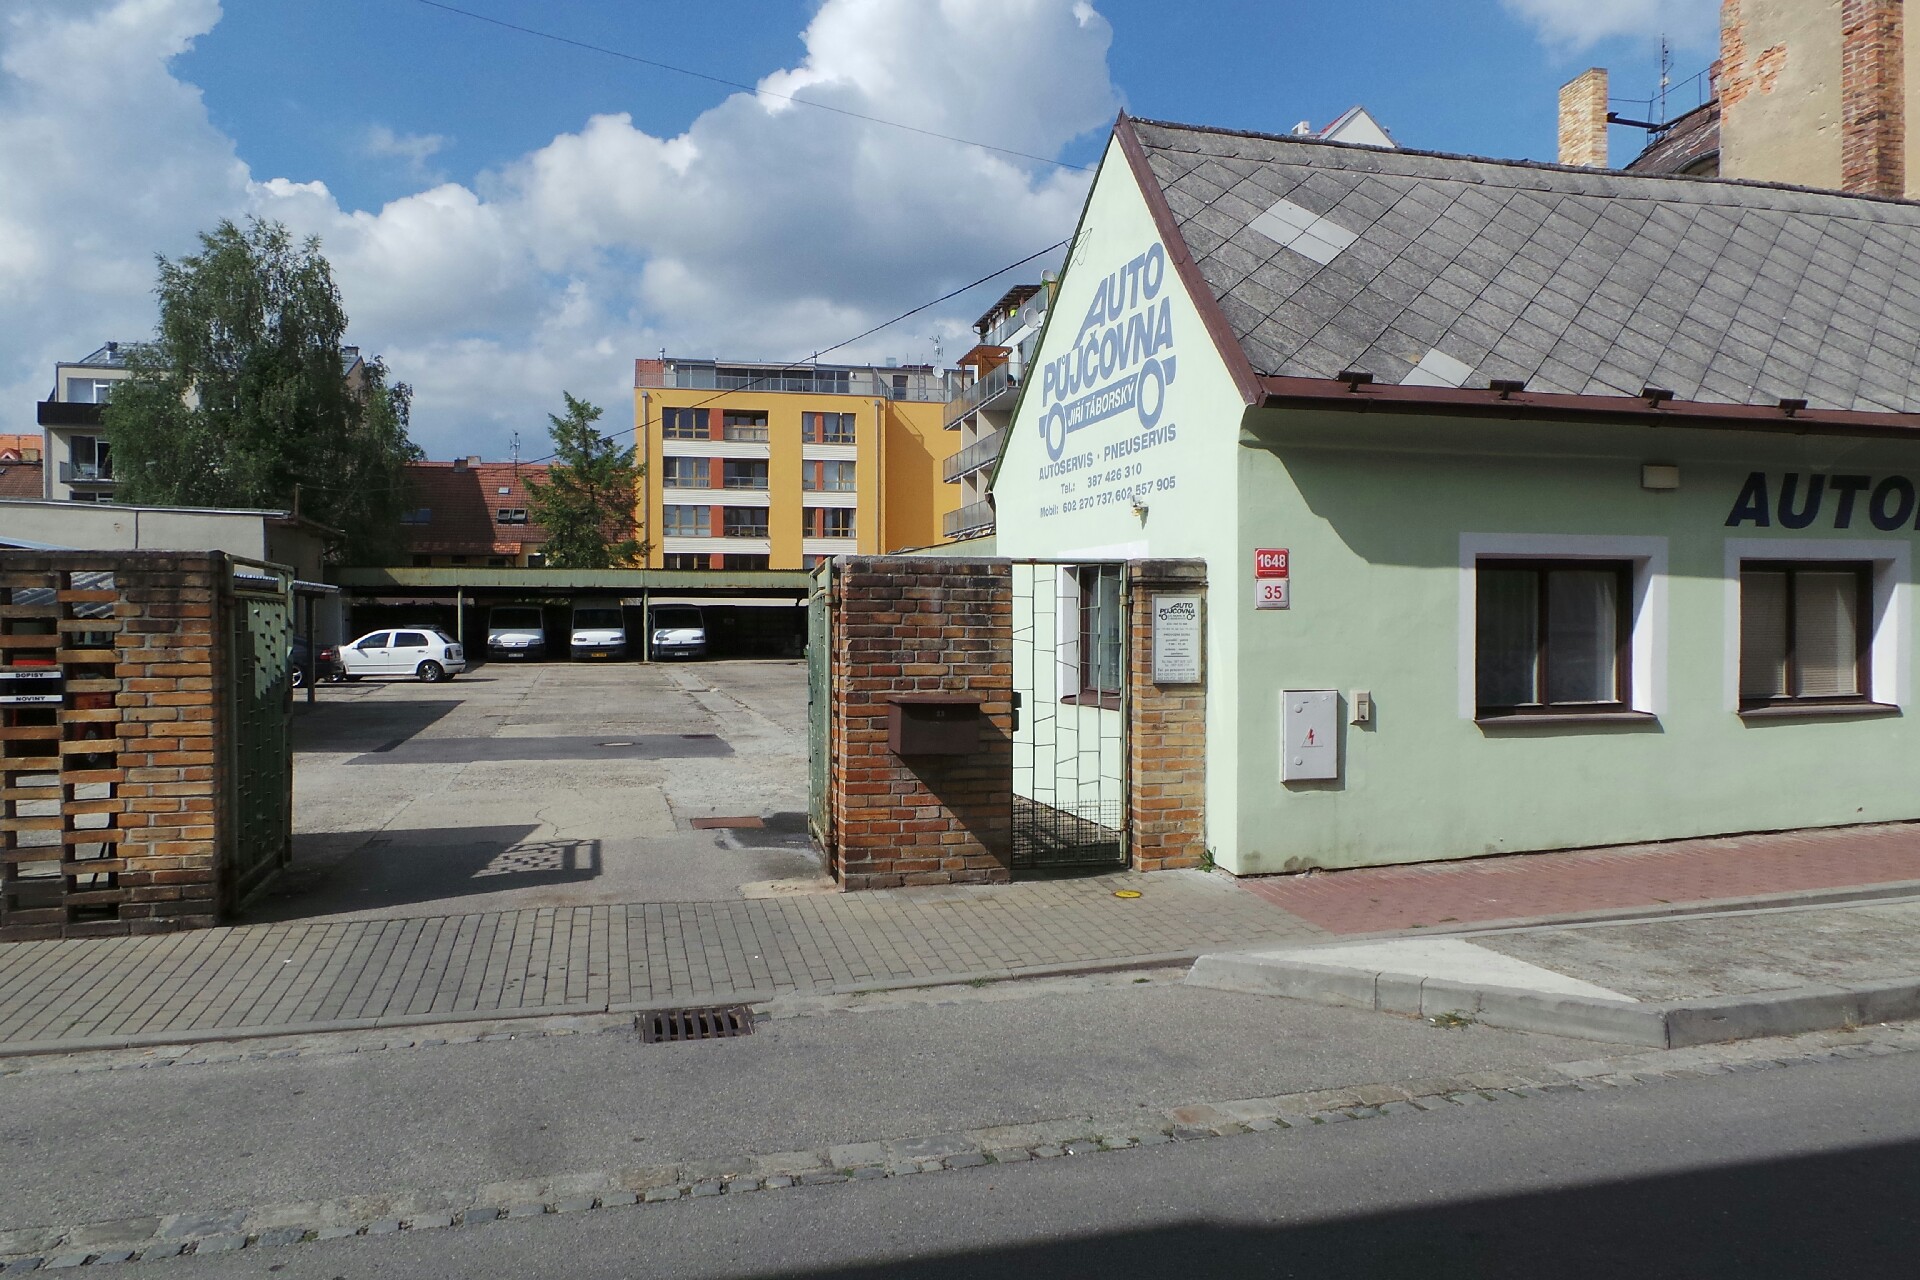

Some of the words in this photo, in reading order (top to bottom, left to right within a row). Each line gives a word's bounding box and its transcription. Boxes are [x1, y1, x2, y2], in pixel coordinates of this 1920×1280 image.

[1072, 242, 1164, 350] AUTO
[1043, 296, 1173, 407] PŮJČOVNA
[1068, 395, 1084, 426] JIŘÍ
[1085, 377, 1136, 416] TÁBORSKÝ
[1039, 451, 1094, 481] AUTOSERVIS
[1104, 423, 1177, 462] PNEUSERVIS
[1040, 504, 1059, 518] Mobil:
[1062, 498, 1077, 513] 602
[1079, 494, 1094, 510] 270
[1115, 484, 1133, 502] 602
[1135, 480, 1153, 496] 557
[1156, 475, 1176, 492] 905
[1061, 482, 1076, 495] Tel.:
[1087, 473, 1103, 488] 387
[1105, 468, 1122, 484] 426
[1124, 462, 1142, 480] 310
[1724, 472, 1920, 531] AUTO
[1257, 554, 1286, 568] 1648
[1170, 602, 1193, 610] AUTO
[1264, 586, 1282, 599] 35
